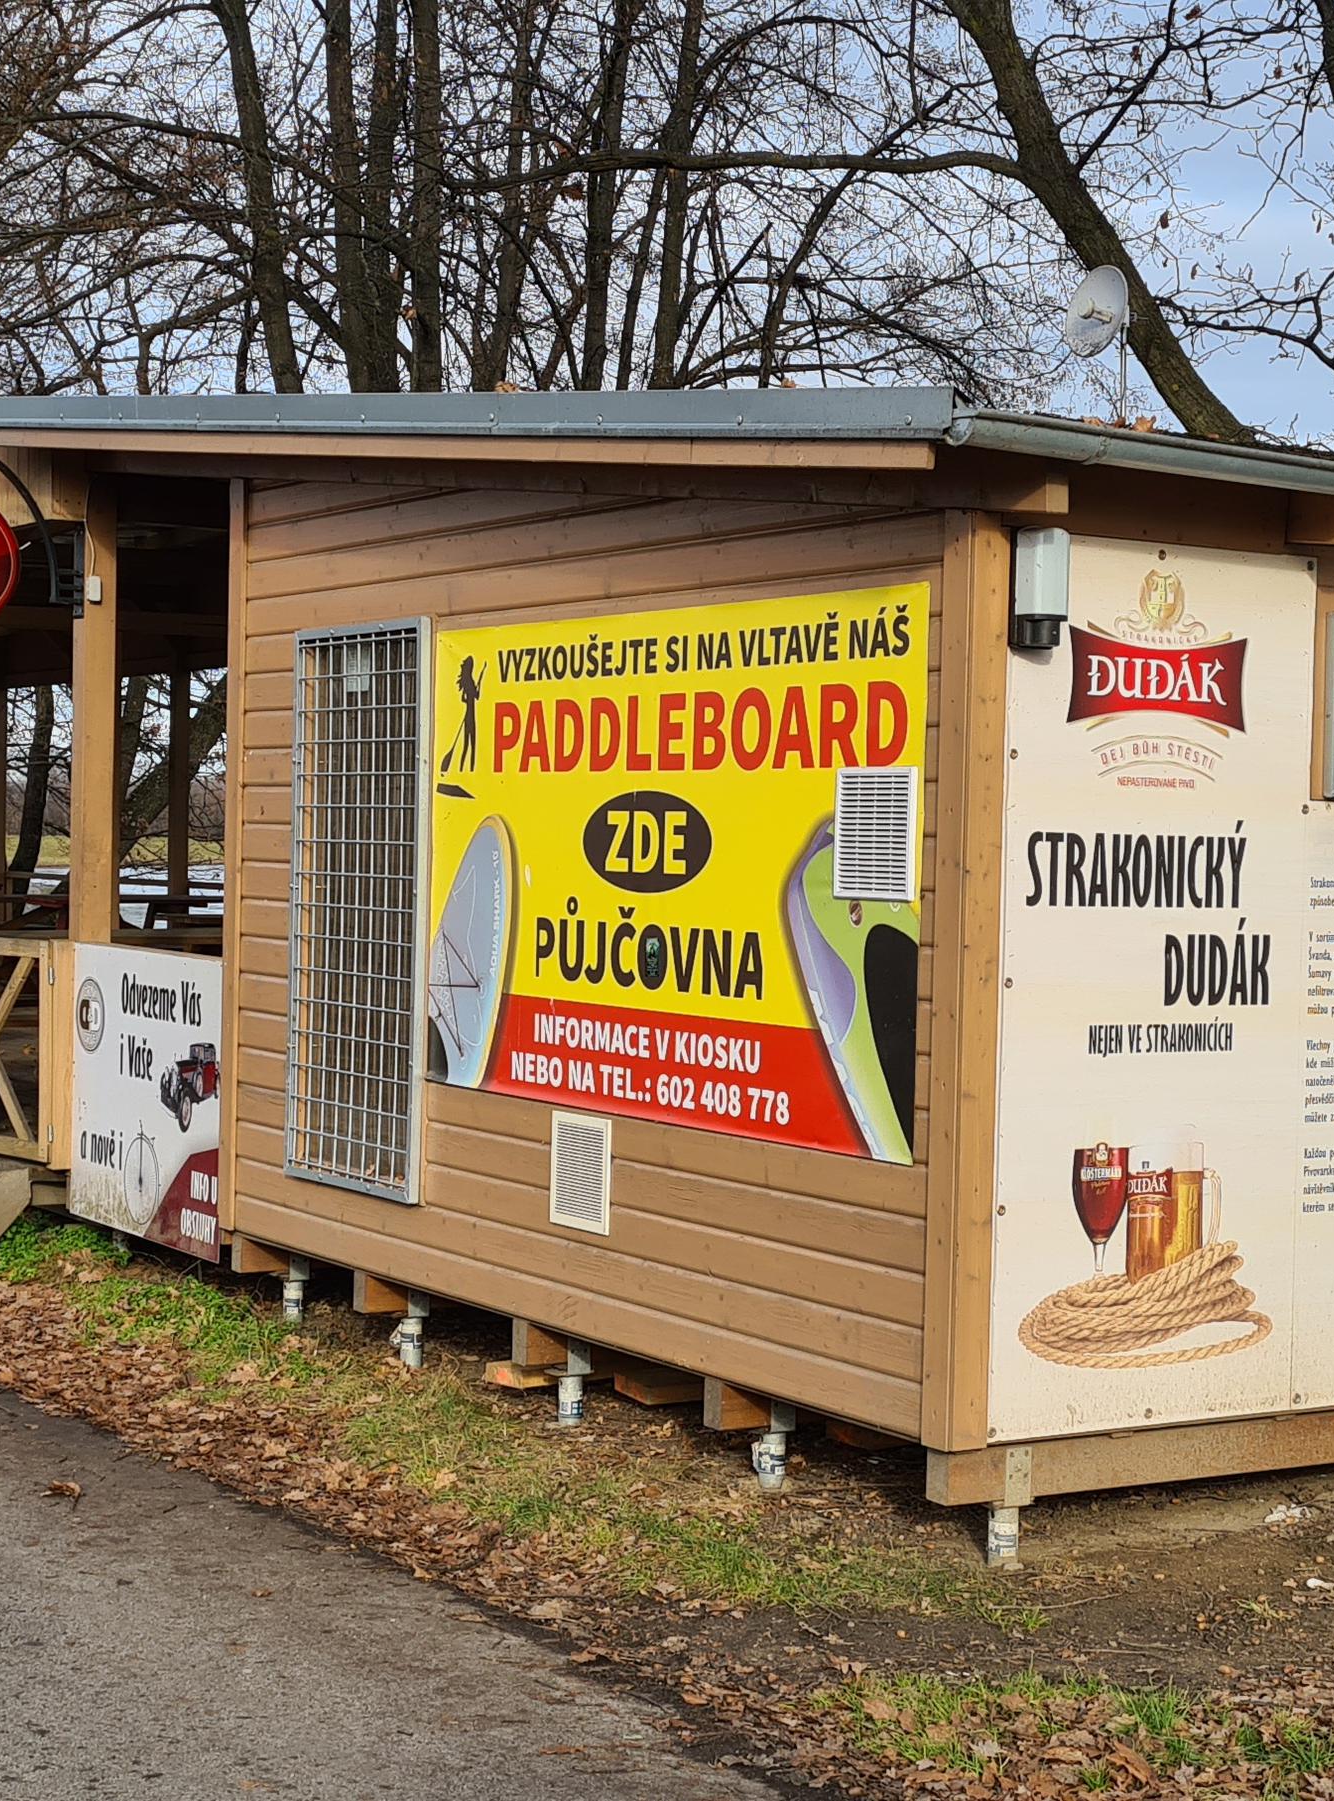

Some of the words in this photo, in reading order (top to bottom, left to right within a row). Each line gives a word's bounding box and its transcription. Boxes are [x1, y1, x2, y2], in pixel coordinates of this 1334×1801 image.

[498, 633, 657, 684] VYZKOUŠEJTE
[664, 637, 690, 672] SI
[696, 632, 732, 670] NA
[738, 612, 838, 668] VLTAVĚ
[847, 604, 910, 660] NÁŠ
[492, 680, 909, 773] PADDLEBOARD
[1100, 746, 1124, 766] DEJ
[1132, 741, 1159, 756] BŮH
[604, 808, 688, 875] ZDE
[1026, 820, 1247, 909] STRAKONICKÝ
[533, 897, 764, 1001] PŮJČOVNA
[1163, 917, 1270, 1007] DUDÁK
[121, 972, 177, 1024] Odvezeme
[180, 980, 202, 1028] Vás
[128, 1035, 153, 1082] Vaše
[532, 1013, 649, 1062] INFORMACE
[653, 1029, 671, 1062] V
[674, 1030, 761, 1074] KIOSKU
[1087, 1024, 1125, 1058] NEJEN
[1129, 1024, 1143, 1054] VE
[1146, 1019, 1233, 1054] STRAKONICÍCH
[510, 1050, 563, 1089] NEBO
[567, 1058, 596, 1093] NA
[598, 1065, 651, 1101] TEL.:
[656, 1071, 695, 1109] 602
[699, 1077, 742, 1118] 408
[747, 1088, 790, 1126] 778
[80, 1132, 87, 1159] a
[90, 1129, 116, 1170] nově
[190, 1170, 208, 1202] INFO
[210, 1174, 218, 1204] U
[180, 1207, 217, 1245] OBSLUHY
